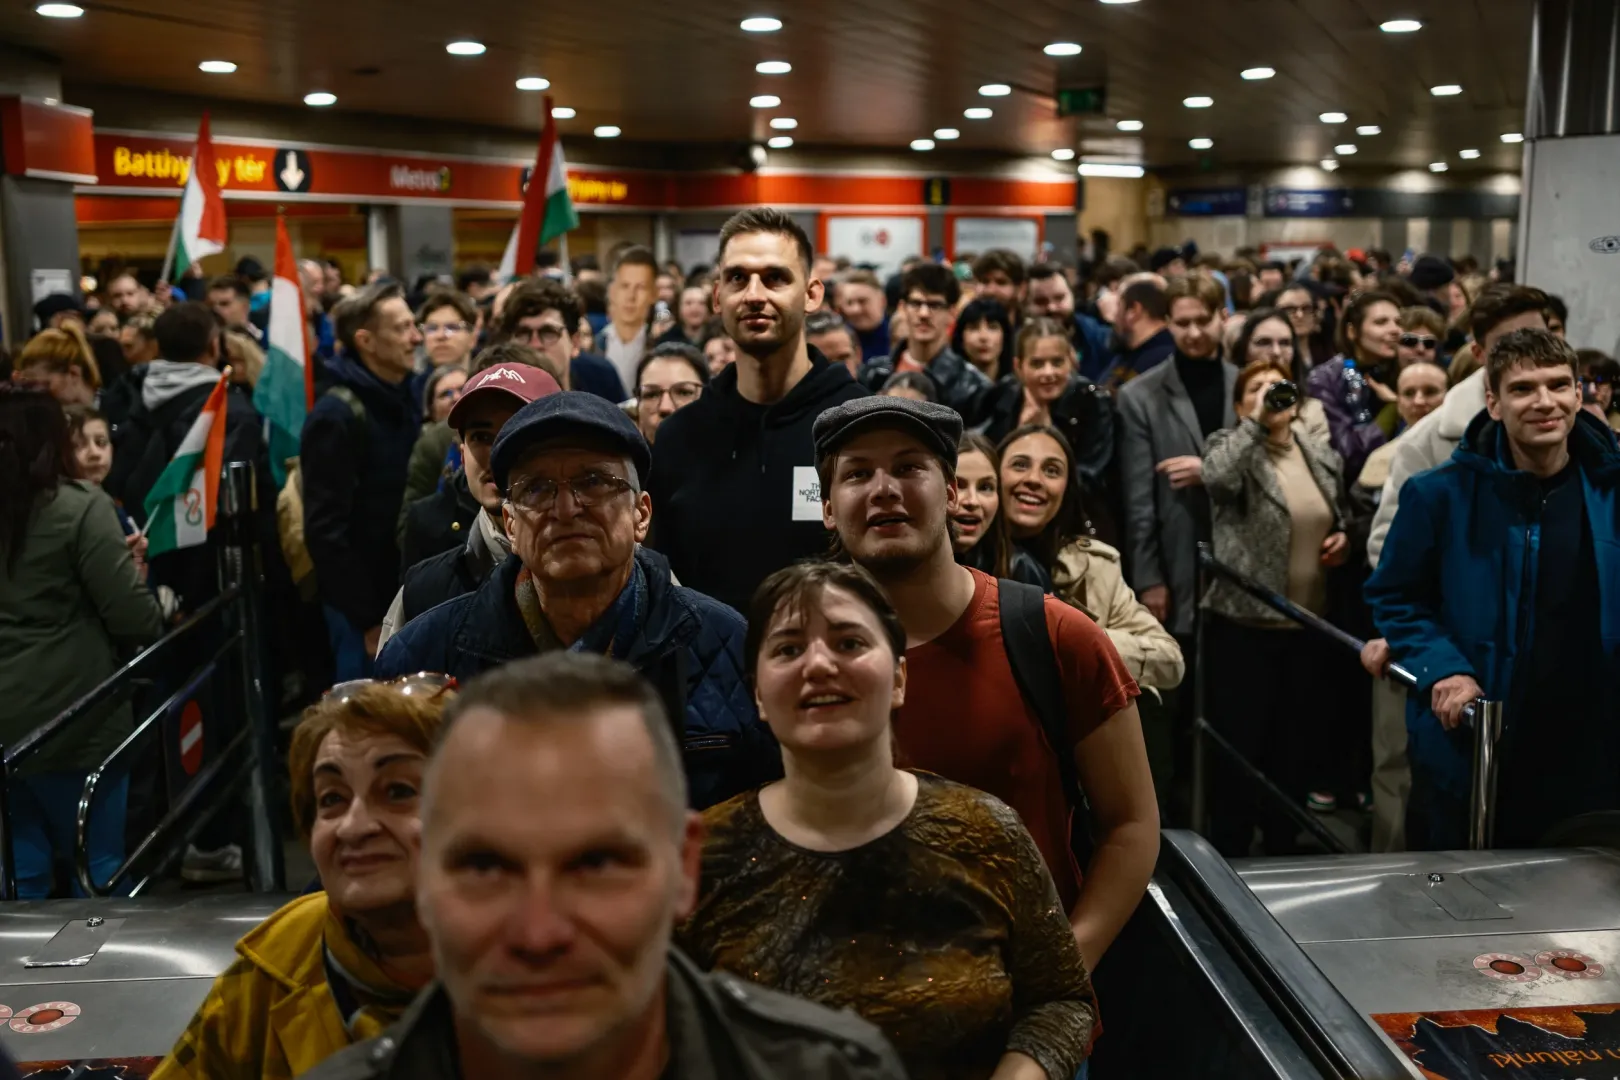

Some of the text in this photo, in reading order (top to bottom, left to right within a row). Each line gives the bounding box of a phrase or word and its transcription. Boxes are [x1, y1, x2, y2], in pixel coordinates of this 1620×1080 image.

[114, 147, 266, 187] Batthyy tér
[1488, 1049, 1602, 1068] nálunk!
